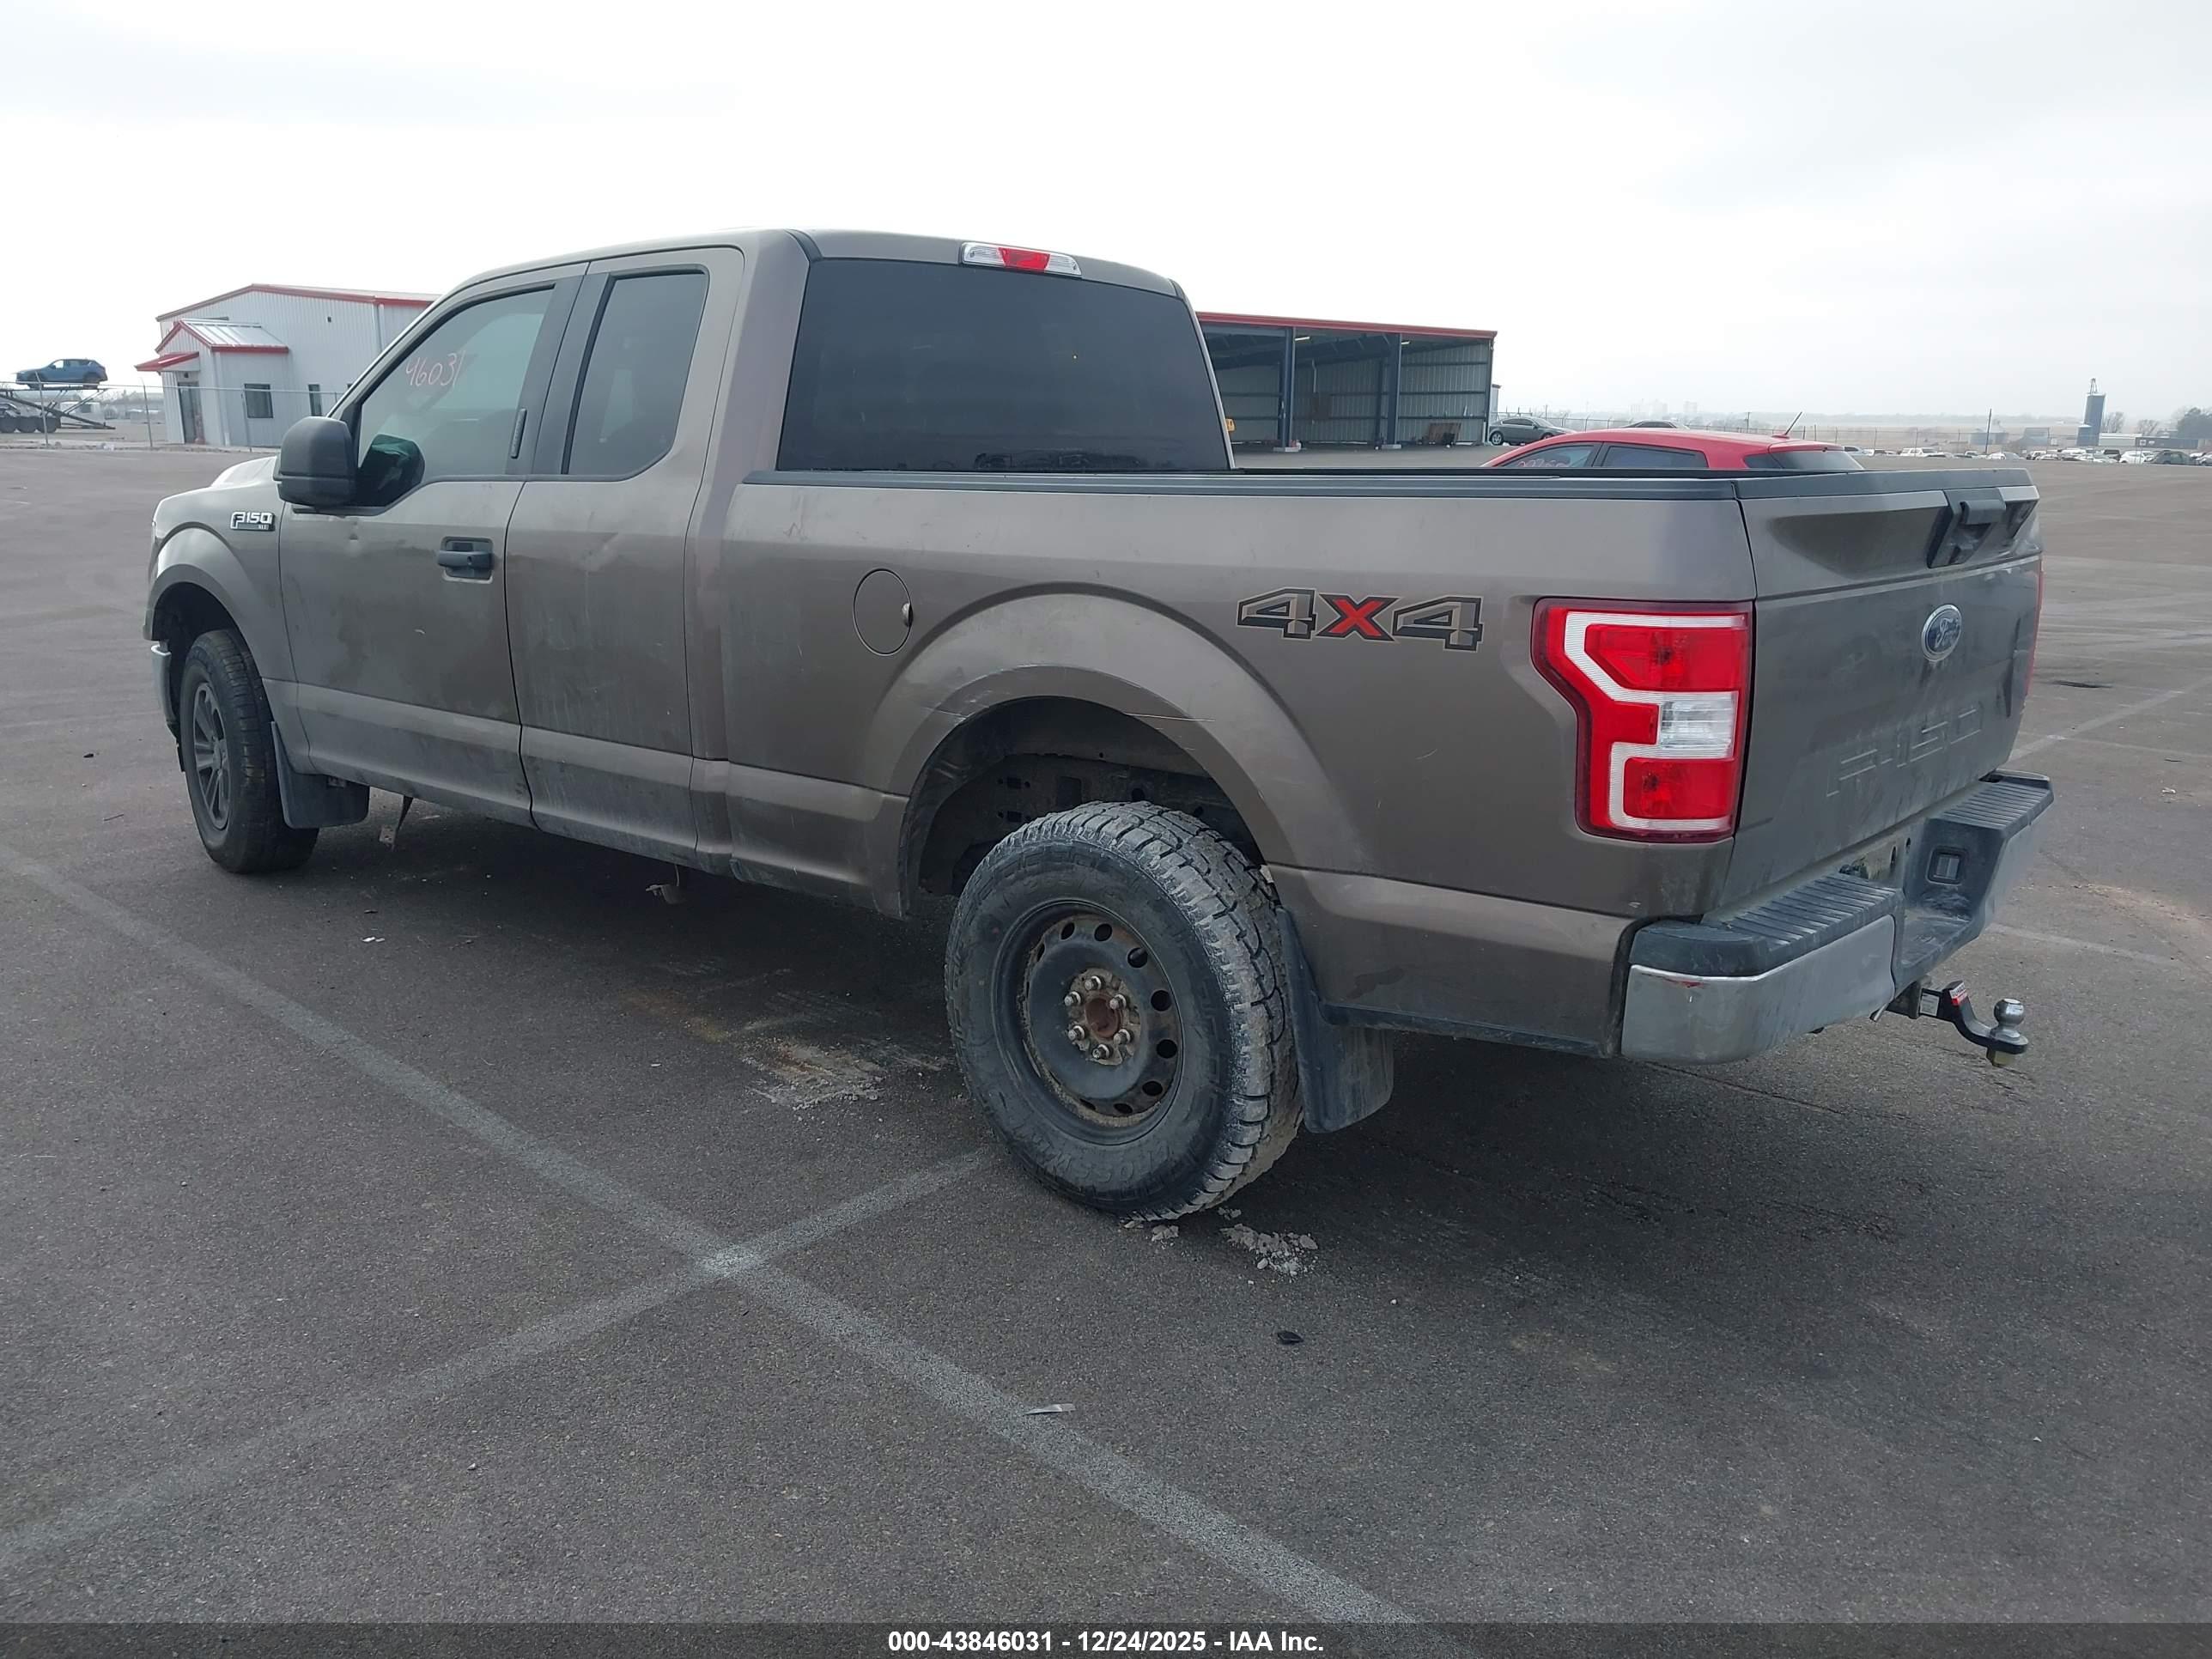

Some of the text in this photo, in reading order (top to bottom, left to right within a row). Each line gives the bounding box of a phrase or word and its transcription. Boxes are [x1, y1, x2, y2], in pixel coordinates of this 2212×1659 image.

[405, 350, 466, 386] 46031
[230, 511, 273, 530] F150
[1237, 586, 1484, 653] 4X4
